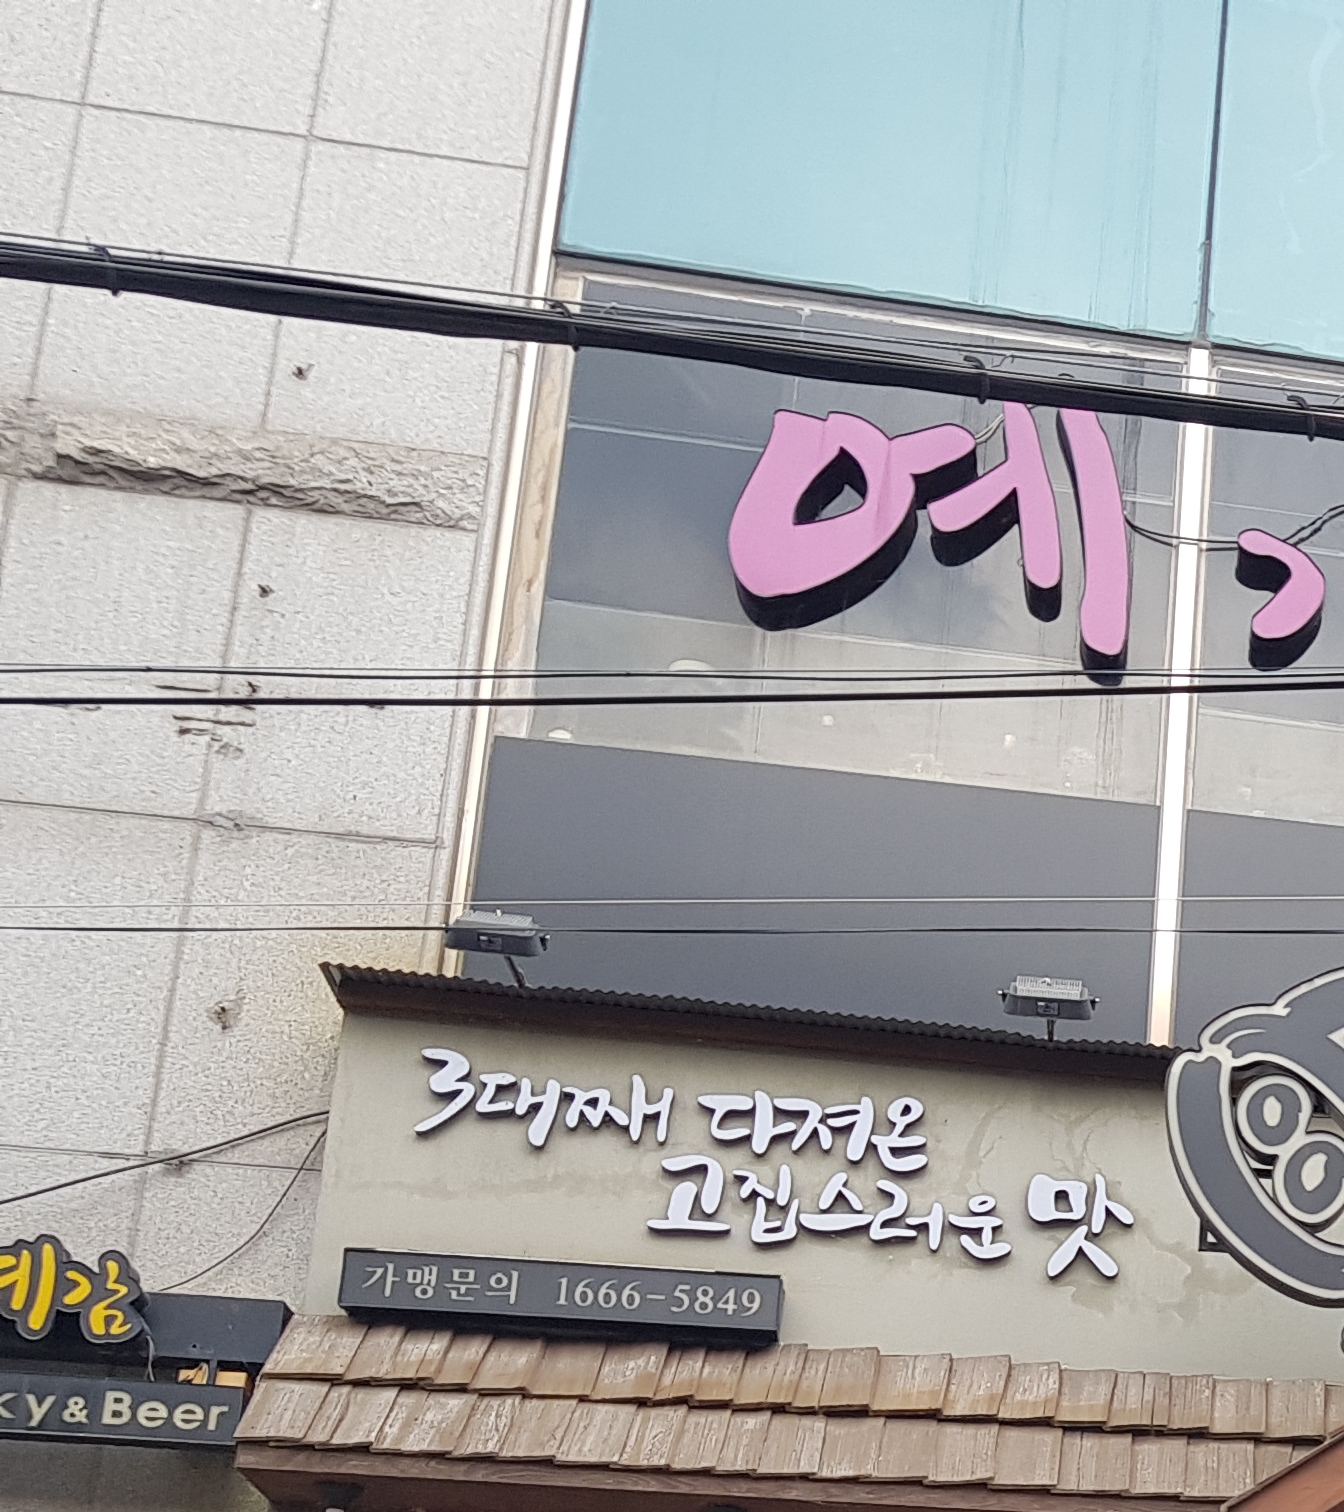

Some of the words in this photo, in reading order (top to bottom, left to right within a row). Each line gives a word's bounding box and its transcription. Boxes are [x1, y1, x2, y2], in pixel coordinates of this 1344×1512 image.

[414, 1047, 674, 1148] 3대째
[697, 1090, 928, 1173] 다져온
[646, 1154, 1013, 1261] 고집스러운
[1026, 1173, 1135, 1280] 맛
[362, 1262, 520, 1303] 가맹문의
[555, 1277, 762, 1317] 1666-5849
